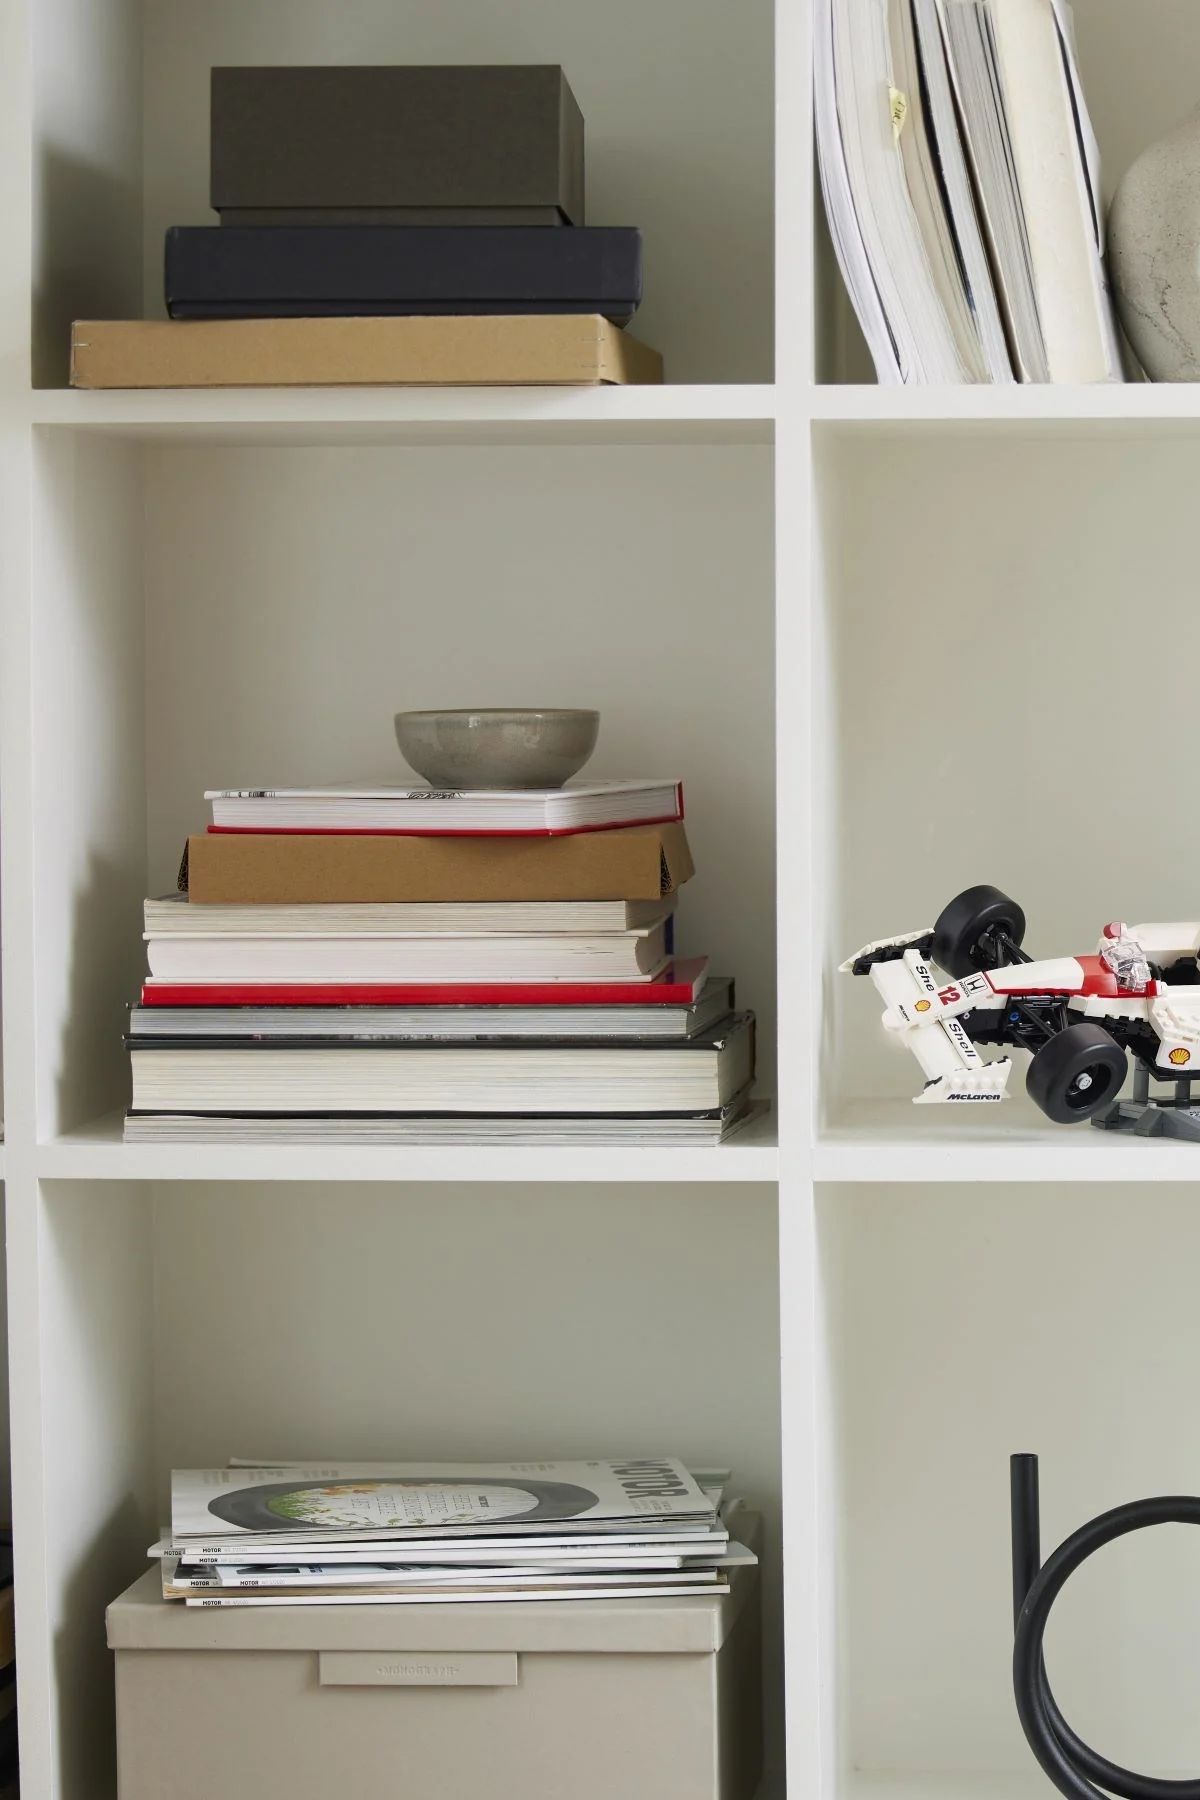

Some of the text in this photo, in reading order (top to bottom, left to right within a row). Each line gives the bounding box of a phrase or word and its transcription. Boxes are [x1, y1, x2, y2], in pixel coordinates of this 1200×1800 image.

[915, 965, 935, 992] She
[937, 985, 961, 1006] 12
[948, 1023, 976, 1058] Shell
[947, 1093, 1001, 1101] McLaren
[607, 1459, 689, 1499] MOTOR
